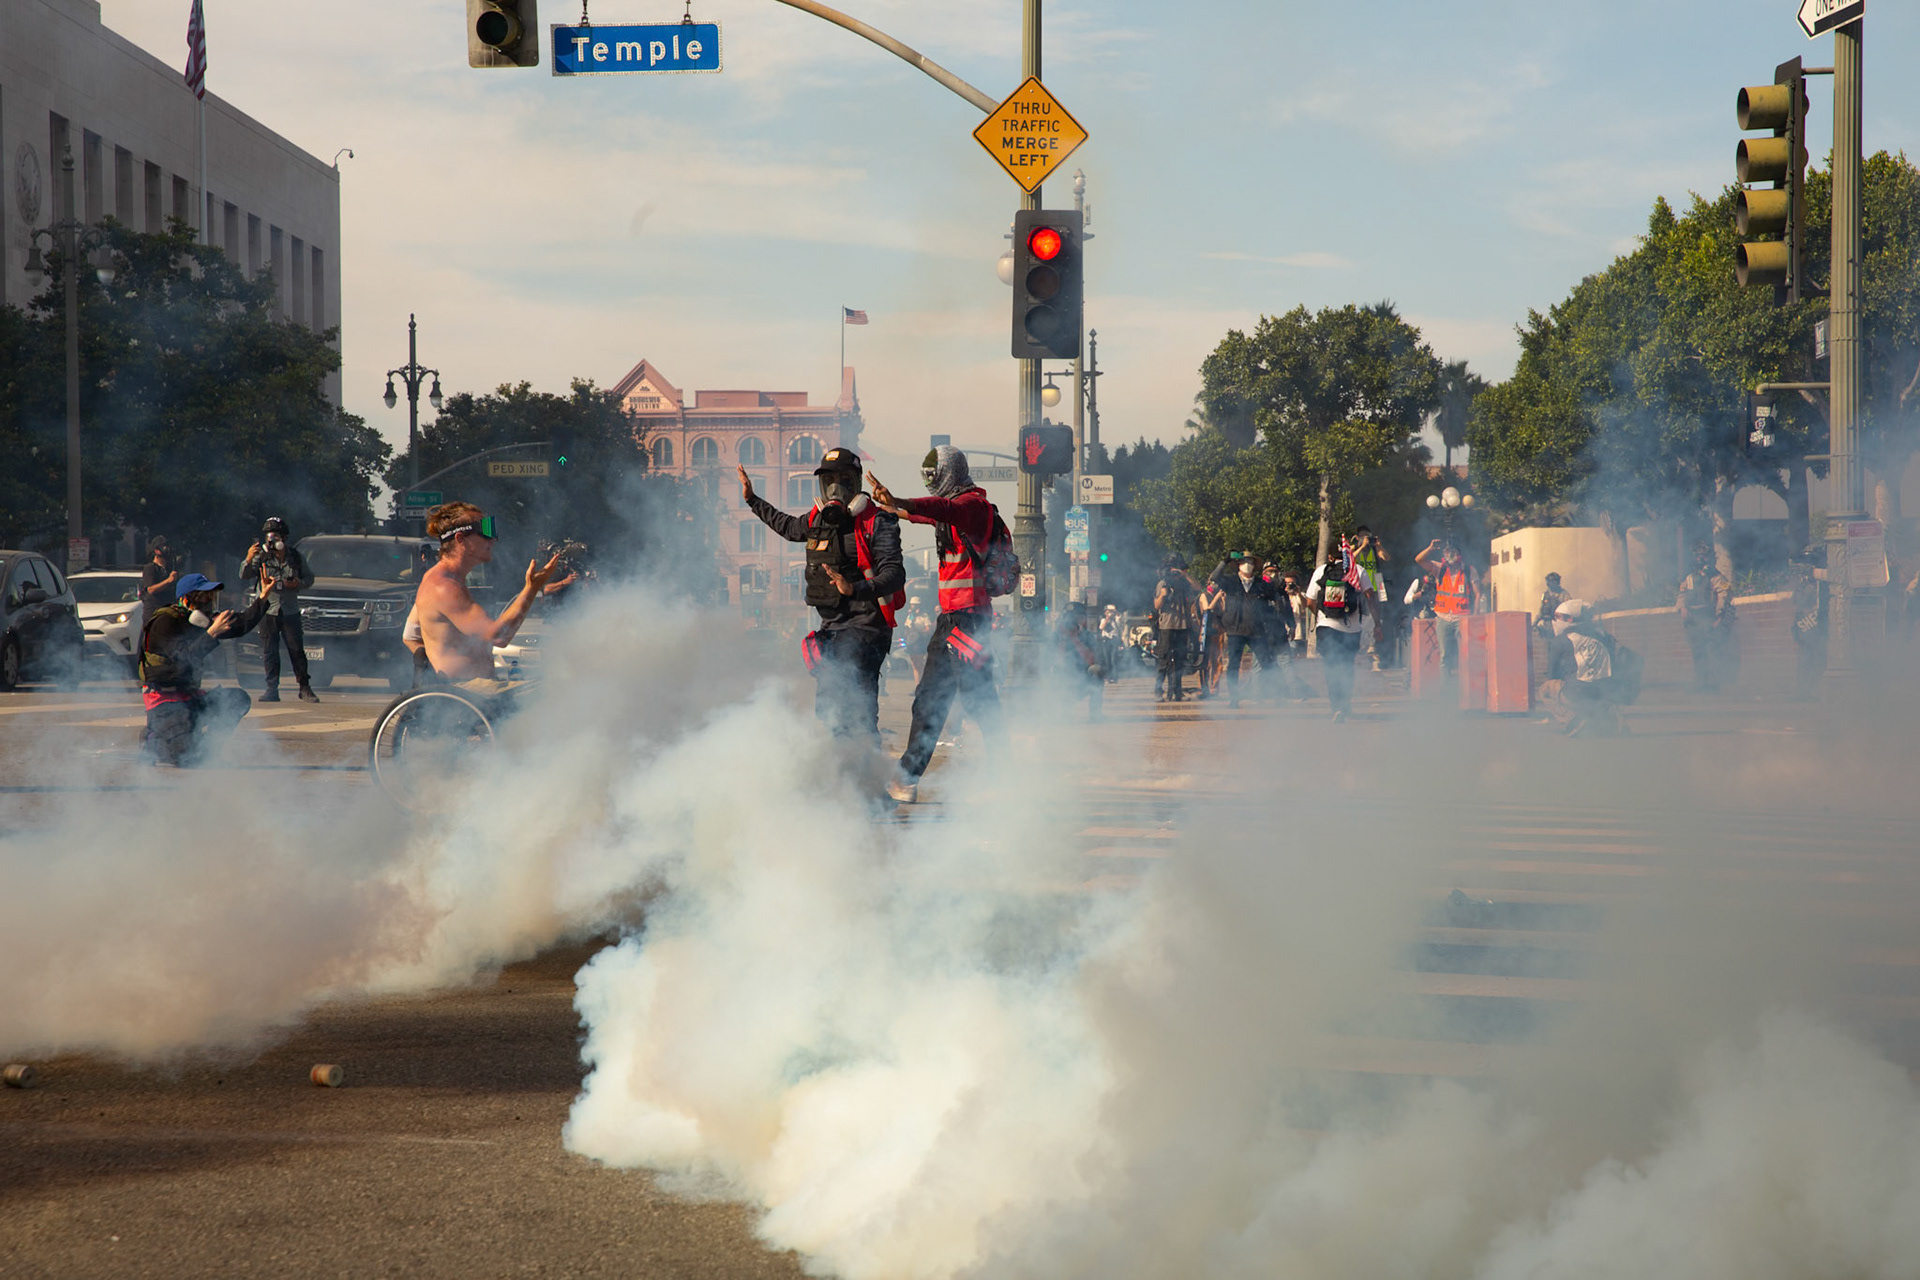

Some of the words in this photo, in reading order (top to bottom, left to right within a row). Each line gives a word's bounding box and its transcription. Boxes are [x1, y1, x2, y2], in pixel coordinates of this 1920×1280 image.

[571, 34, 703, 67] Temple
[1012, 102, 1051, 115] THRU
[1002, 119, 1060, 132] TRAFFIC
[1002, 137, 1059, 149] MERGE
[1009, 154, 1049, 166] LEFT
[493, 464, 514, 474] PED
[519, 464, 544, 474] XING
[969, 469, 984, 479] ED
[988, 469, 1013, 479] XING
[1067, 519, 1087, 529] BUS
